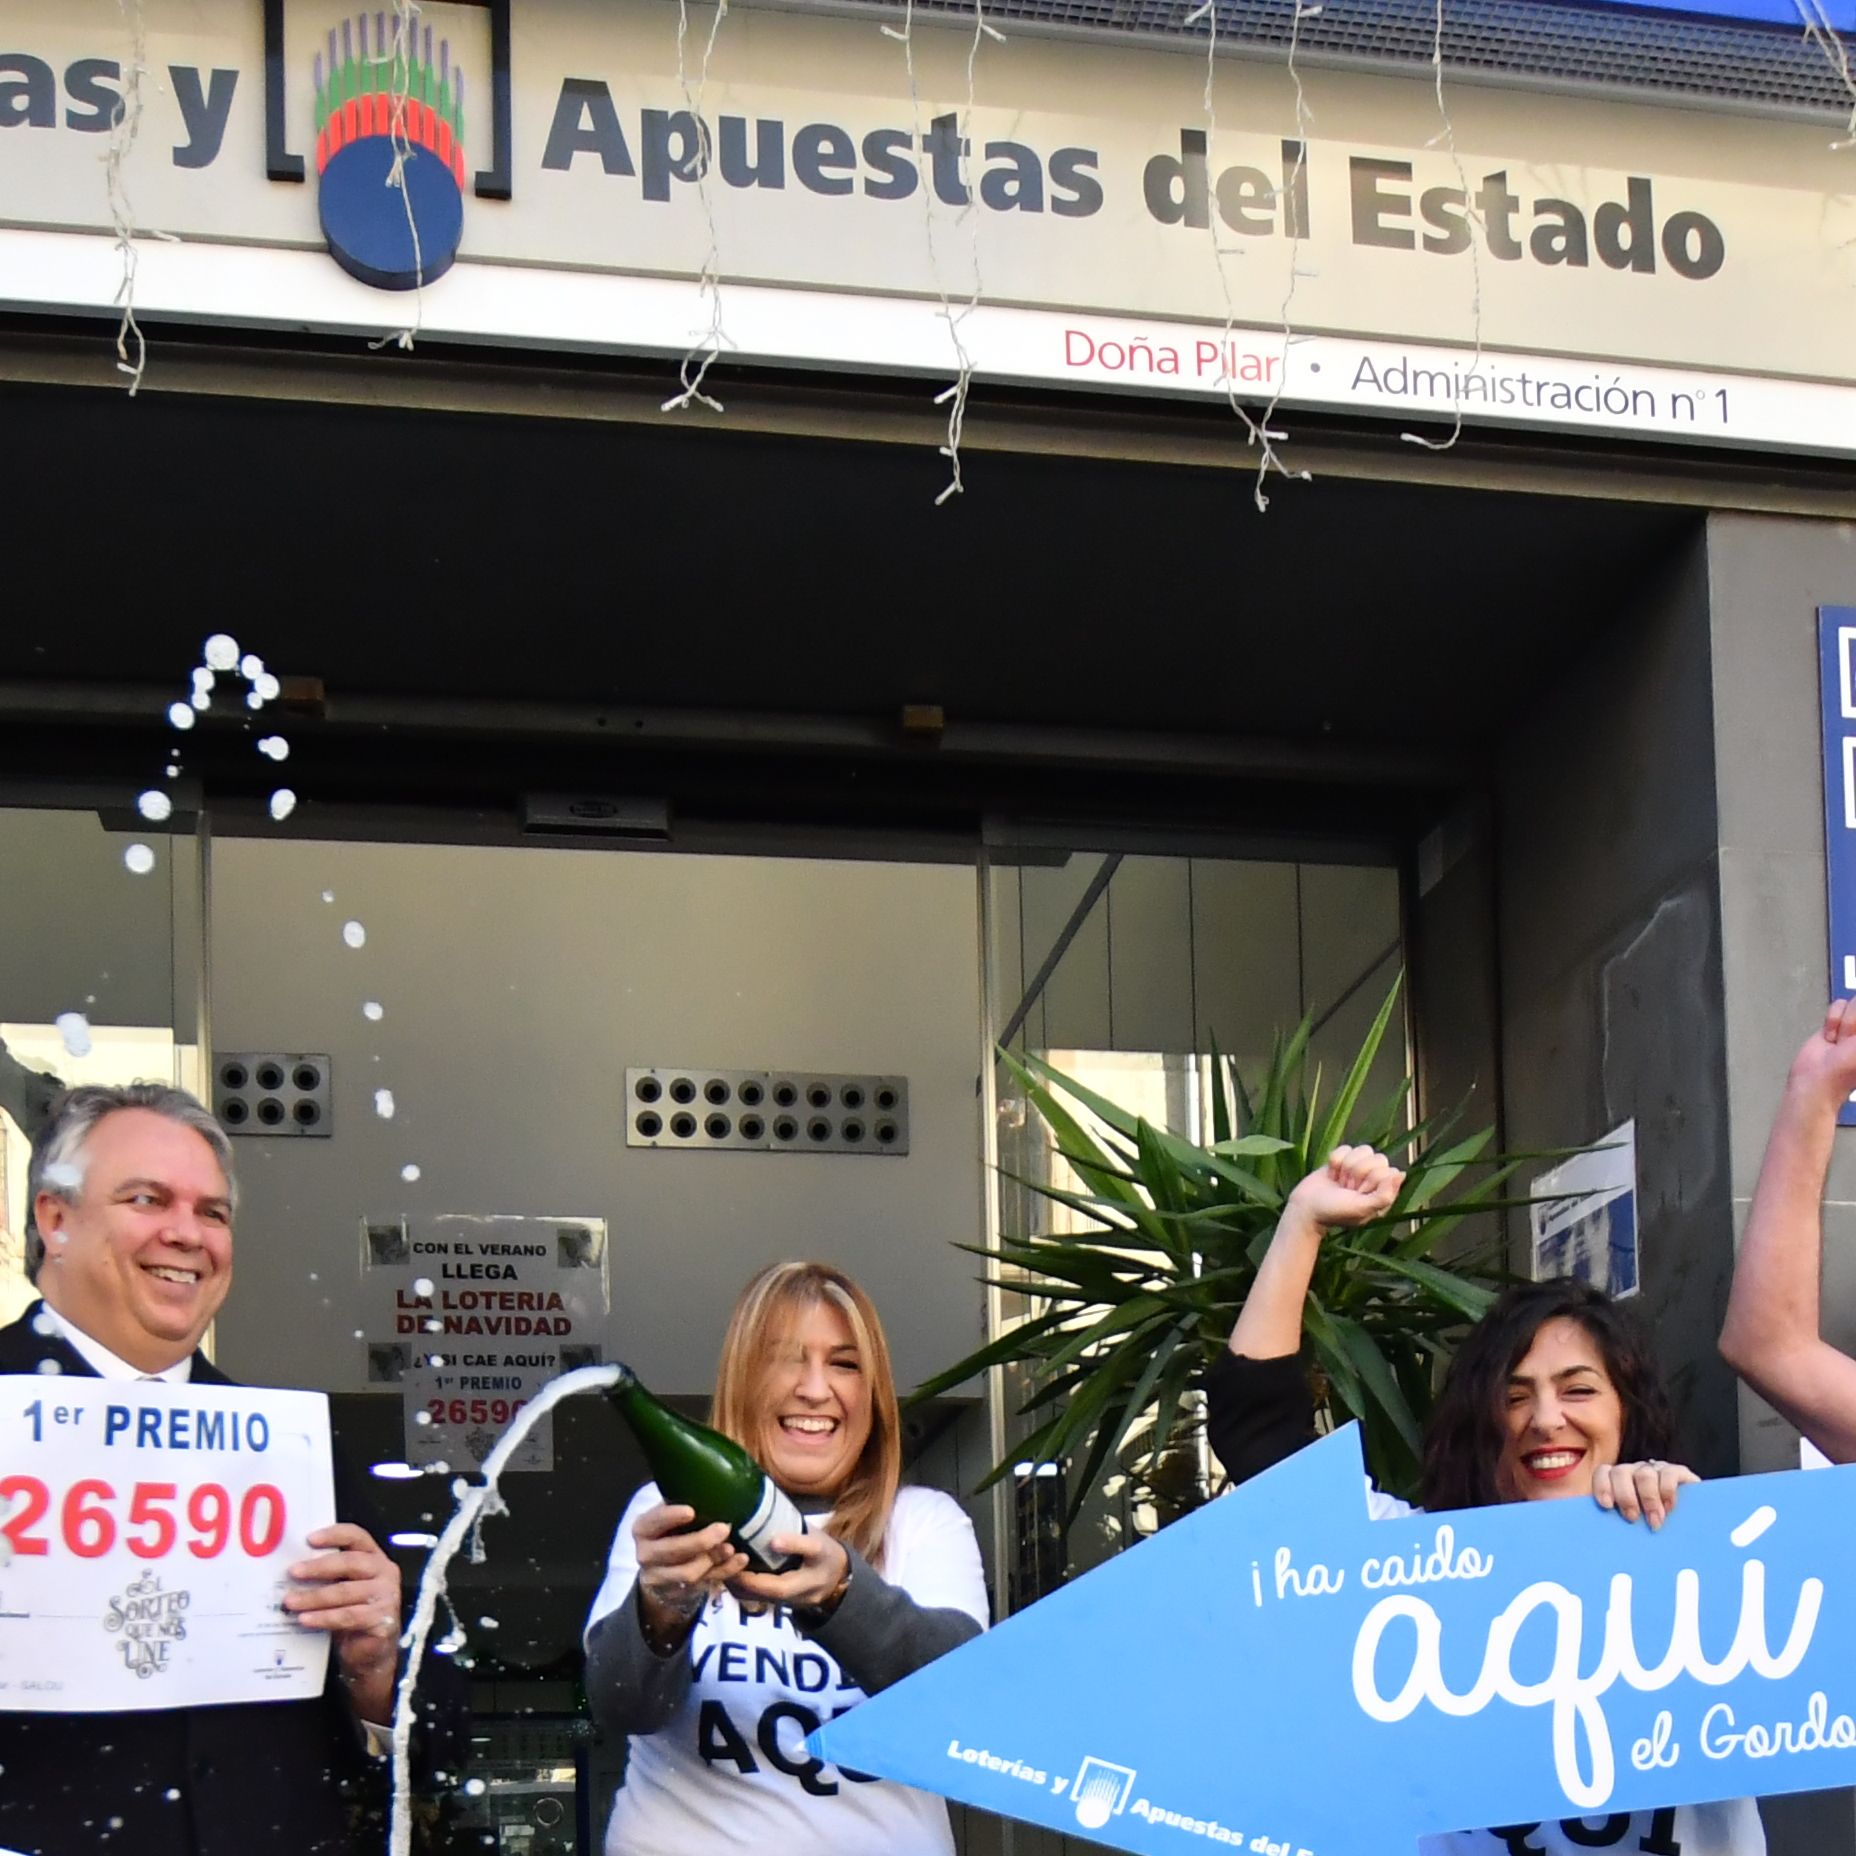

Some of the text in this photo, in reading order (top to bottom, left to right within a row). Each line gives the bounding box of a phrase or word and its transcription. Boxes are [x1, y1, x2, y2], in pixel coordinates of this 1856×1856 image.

[169, 62, 241, 169] y
[540, 77, 1727, 284] Apuestas del Estado
[1063, 329, 1181, 375] Doña
[1195, 342, 1281, 382] Pilar
[1352, 355, 1655, 418] Administración
[413, 1243, 547, 1256] CON EL VERANO
[442, 1263, 518, 1280] LLEGA
[396, 1314, 572, 1336] DE NAVIDAD
[442, 1290, 565, 1311] LOTERIA
[460, 1376, 522, 1390] PREMIO
[463, 1354, 497, 1367] CAE
[103, 1405, 271, 1452] PREMIO
[1361, 1524, 1494, 1589] caido
[1352, 1505, 1824, 1808] aquí
[1631, 1710, 1679, 1771] el
[947, 1739, 1070, 1795] Loterías y
[1129, 1797, 1245, 1847] Apuestas
